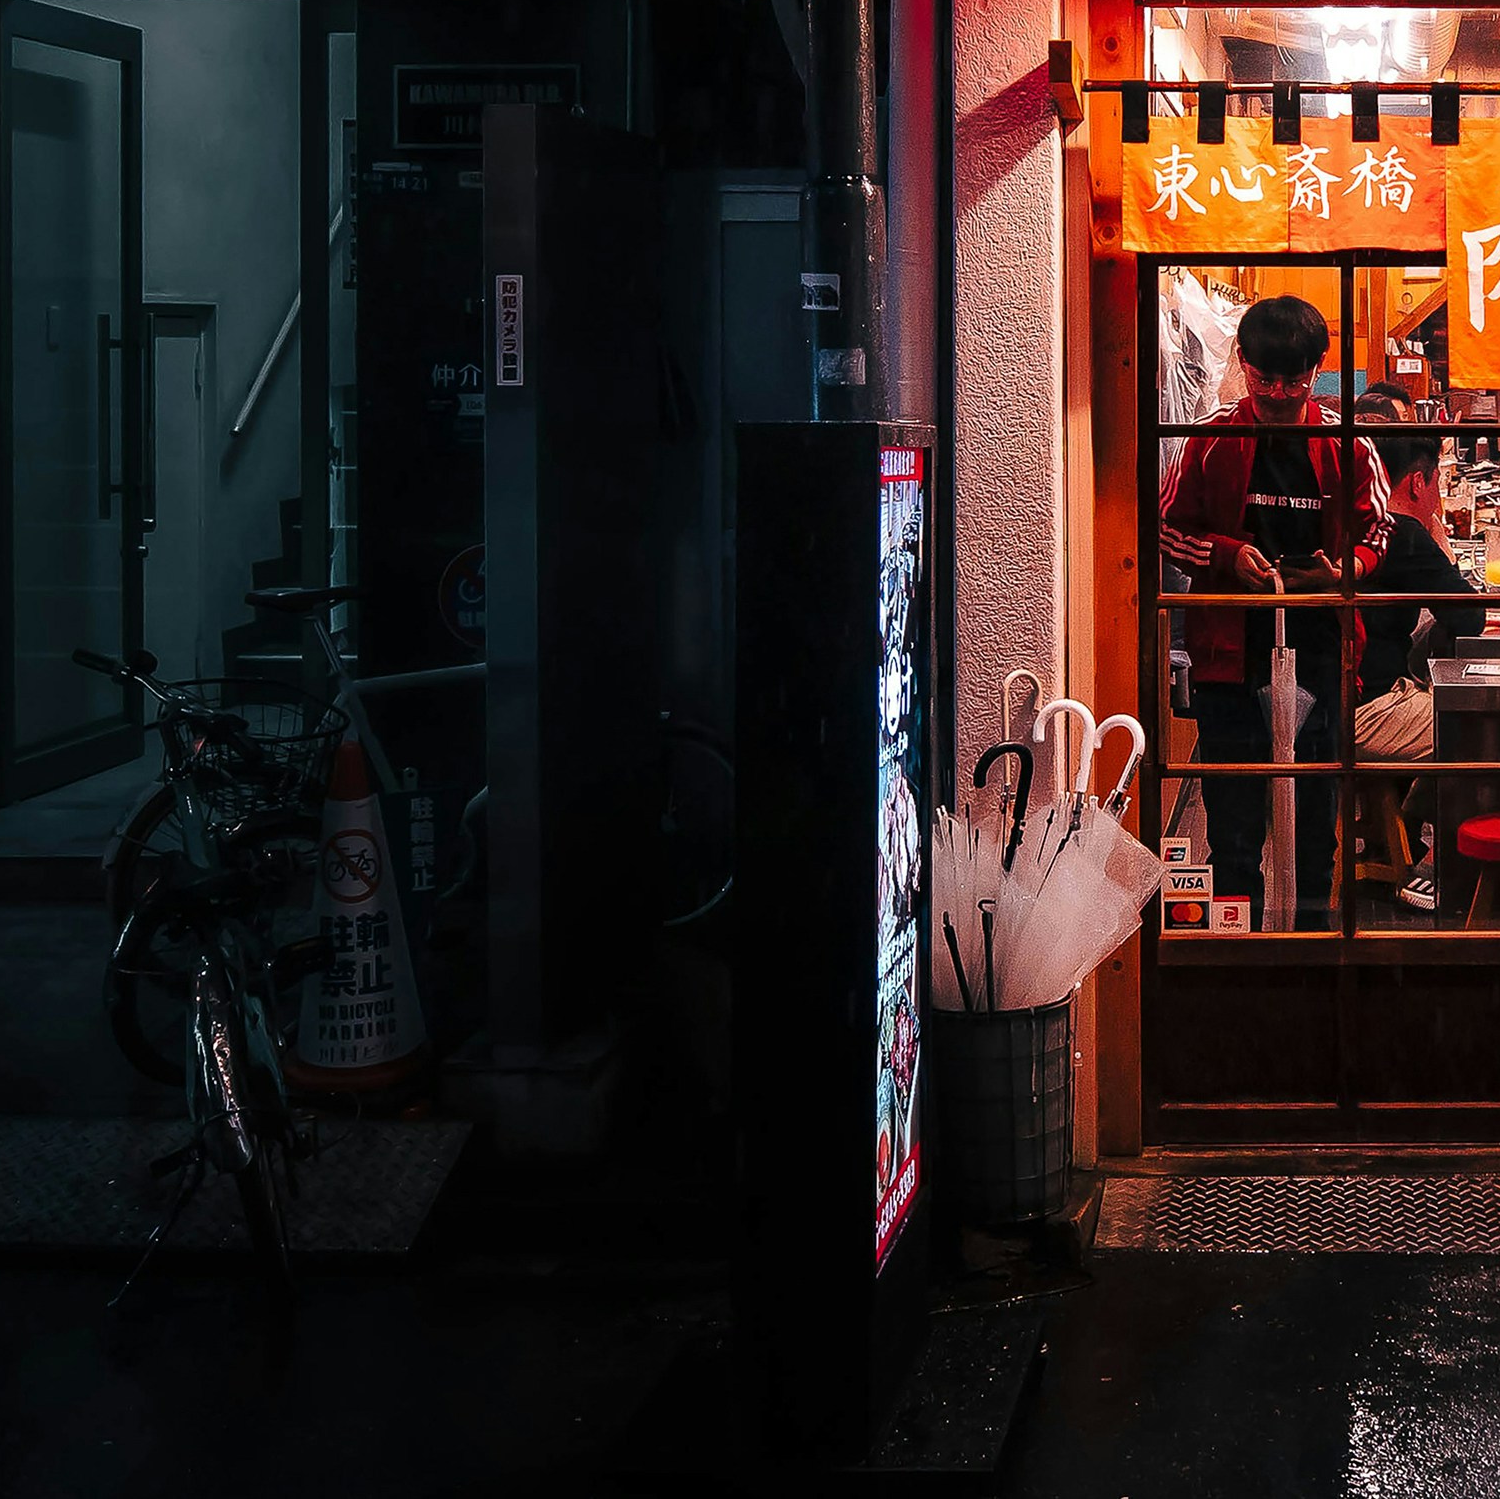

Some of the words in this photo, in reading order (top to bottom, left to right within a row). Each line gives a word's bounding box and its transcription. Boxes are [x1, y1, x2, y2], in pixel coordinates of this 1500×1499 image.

[1147, 143, 1417, 221] 東心斎橋
[1278, 496, 1288, 506] IS
[1170, 877, 1205, 889] VISA
[320, 910, 390, 952] 駐輪
[322, 955, 394, 997] 禁止
